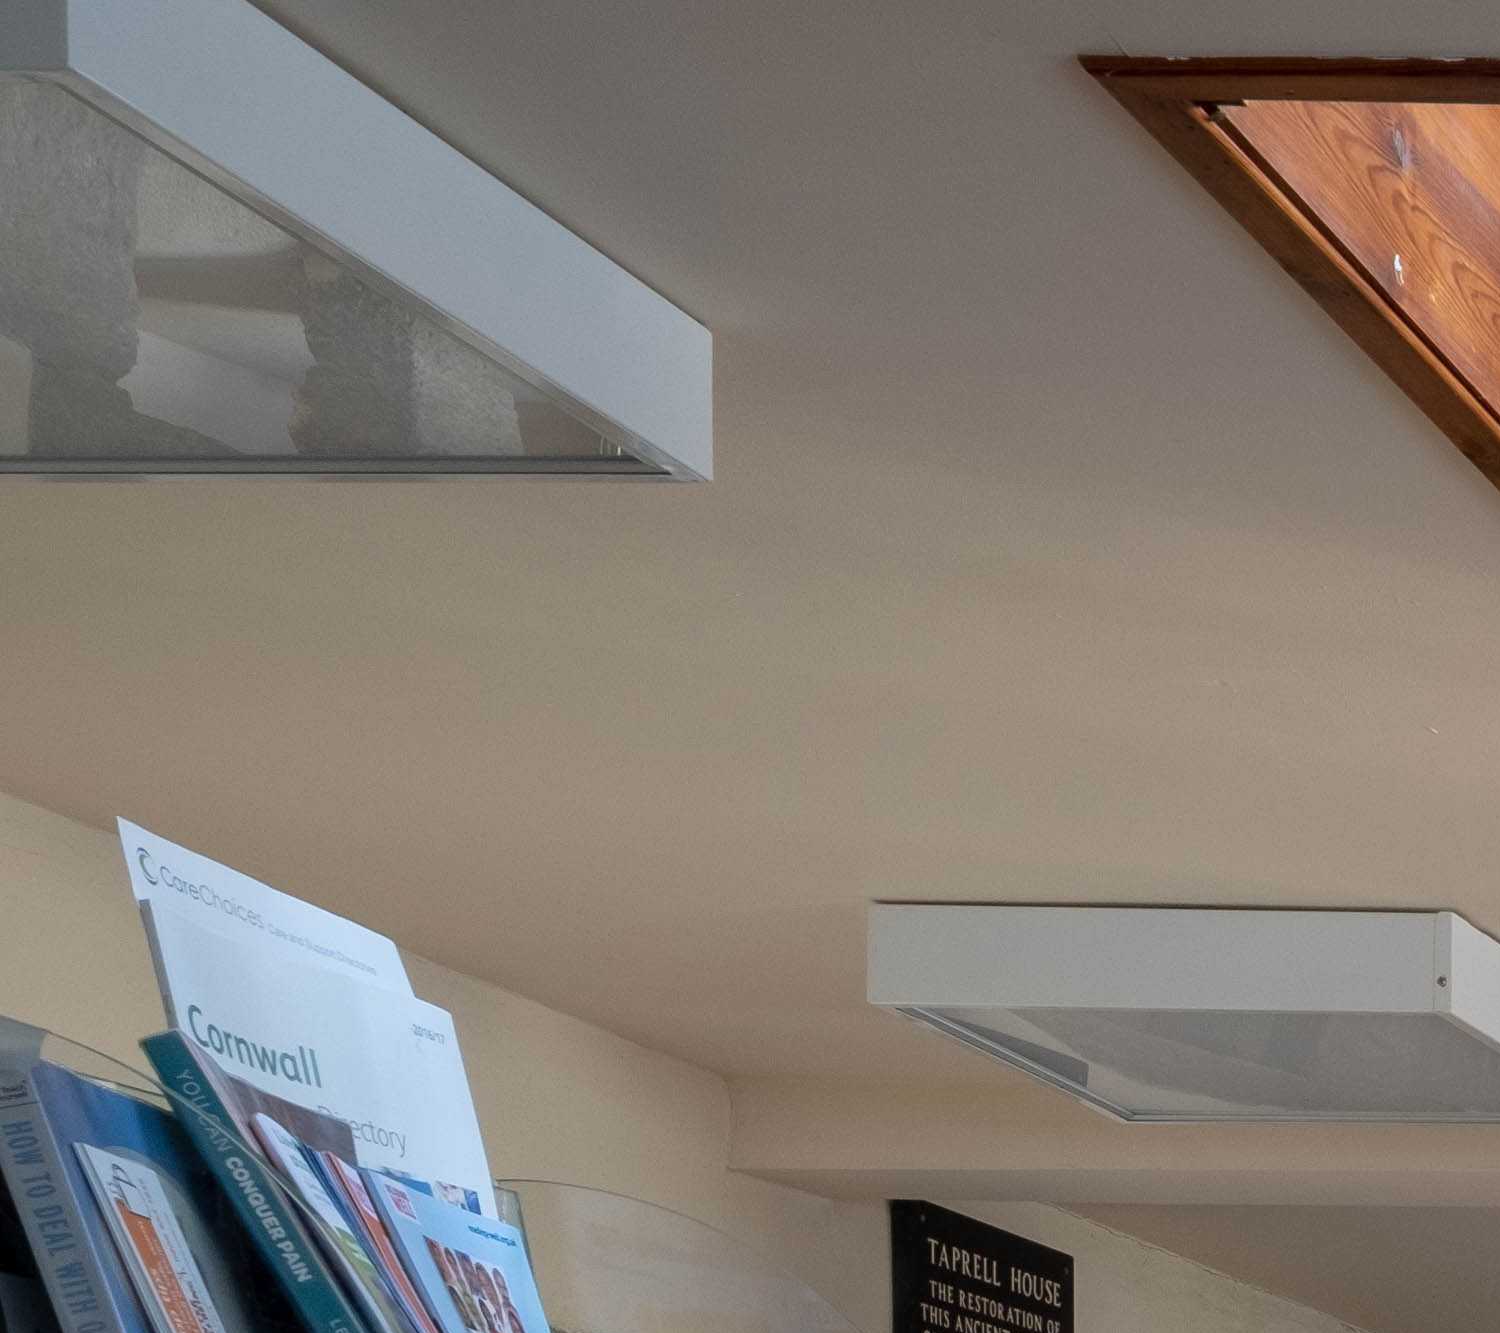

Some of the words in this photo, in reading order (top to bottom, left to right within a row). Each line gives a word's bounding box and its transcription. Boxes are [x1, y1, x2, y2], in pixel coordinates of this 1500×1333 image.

[186, 1003, 323, 1089] Cornwall
[2, 1120, 46, 1175] HOW
[24, 1172, 59, 1207] TO
[33, 1203, 71, 1257] DEAL
[225, 1156, 288, 1245] CONQUER
[272, 1238, 310, 1282] PAIN
[53, 1258, 99, 1319] WITH
[927, 1237, 1001, 1287] TAPRELL
[1010, 1266, 1062, 1308] HOUSE
[921, 1302, 951, 1329] THIS
[930, 1280, 955, 1304] THE
[960, 1289, 1043, 1333] RESTORATION
